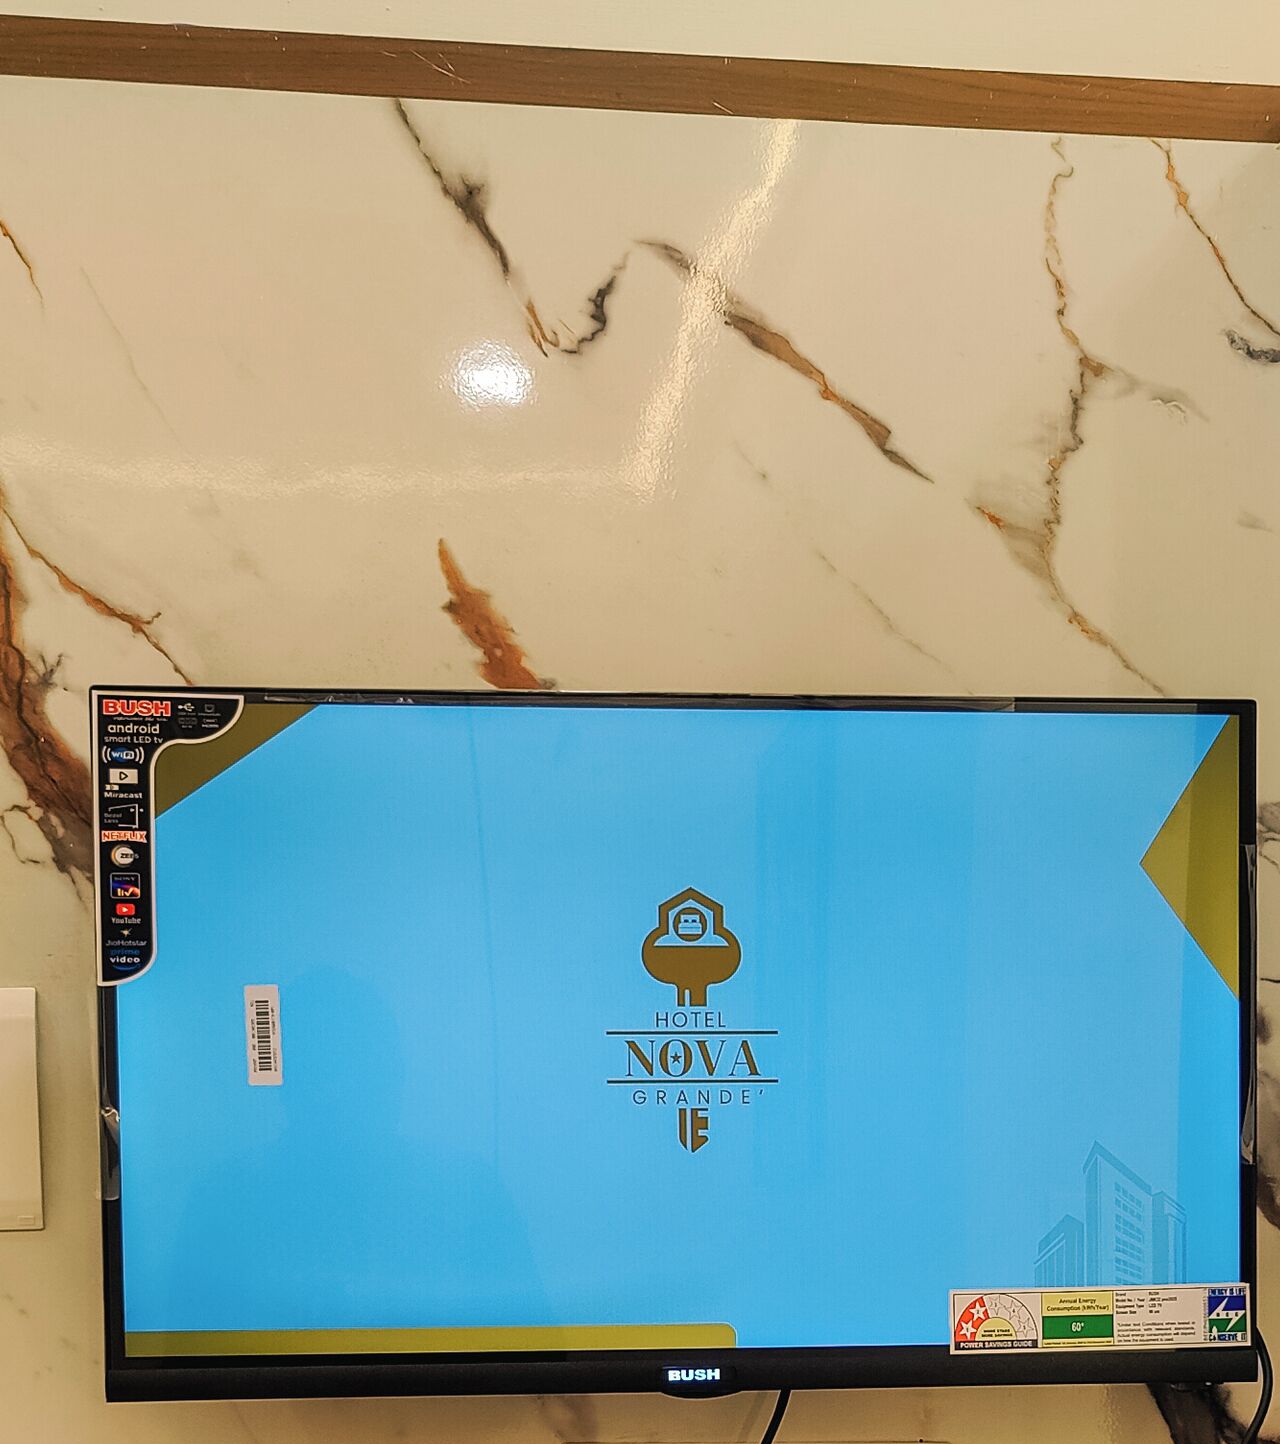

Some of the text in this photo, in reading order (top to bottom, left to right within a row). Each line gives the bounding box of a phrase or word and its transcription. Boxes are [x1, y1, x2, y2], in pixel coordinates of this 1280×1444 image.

[103, 699, 171, 716] BUSH
[107, 723, 160, 734] android
[104, 735, 131, 743] smart
[104, 791, 142, 799] Miracast
[101, 830, 147, 843] NETFLIX
[655, 1012, 726, 1028] HOTEL
[624, 1039, 761, 1077] NOVA
[668, 1369, 720, 1381] BUSH
